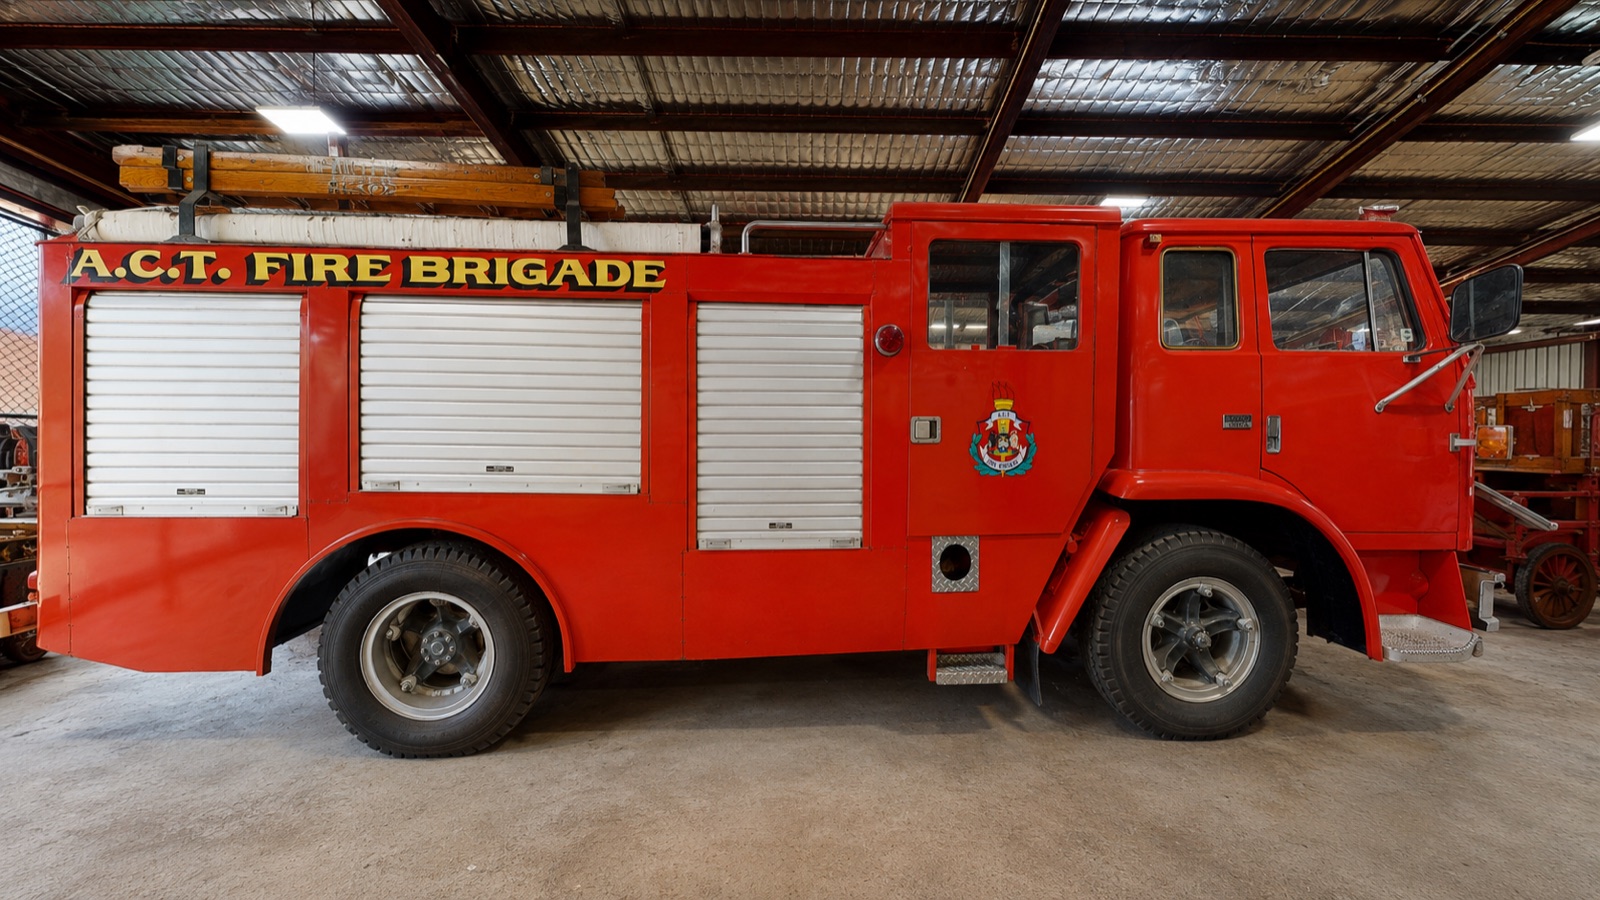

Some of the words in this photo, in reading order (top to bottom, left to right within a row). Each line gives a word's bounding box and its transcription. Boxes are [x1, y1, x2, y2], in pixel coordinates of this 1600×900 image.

[67, 249, 231, 282] A.C.T.
[250, 252, 392, 283] FIRE
[406, 256, 667, 288] BRIGADE
